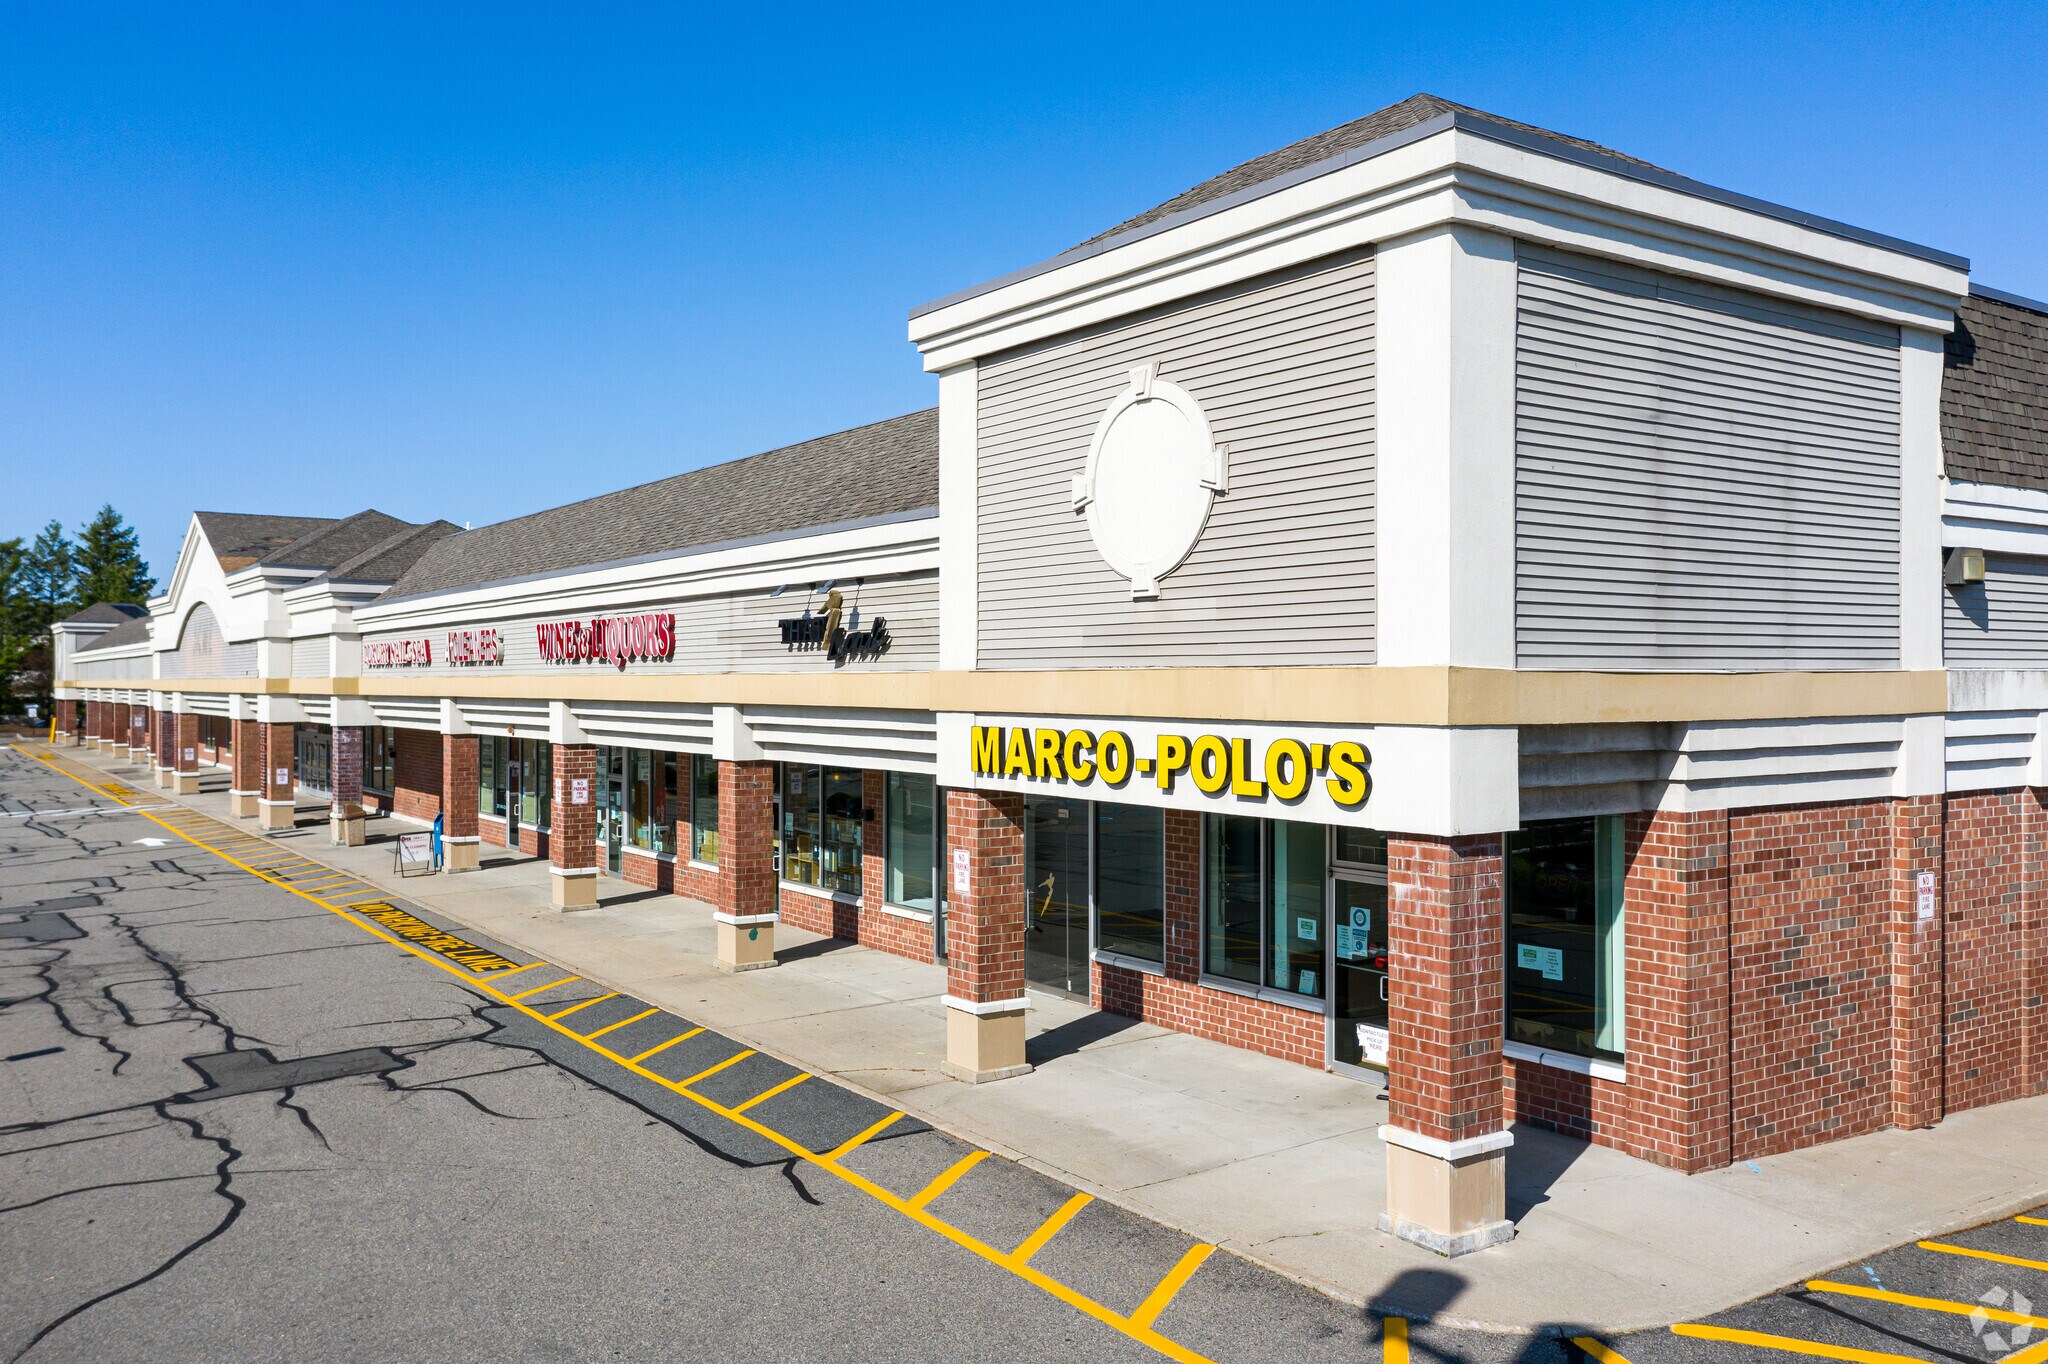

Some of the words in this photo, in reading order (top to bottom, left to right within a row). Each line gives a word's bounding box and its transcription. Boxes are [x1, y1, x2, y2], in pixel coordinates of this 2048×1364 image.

[537, 621, 577, 660] WINE
[579, 627, 590, 659] &
[591, 613, 672, 667] LIQUORS
[971, 726, 1369, 805] MARCO-POLO'S
[958, 854, 965, 862] NO
[955, 862, 969, 871] PARKING
[1922, 876, 1930, 885] NO
[1919, 885, 1933, 895] PARKING
[1922, 895, 1930, 903] FIRE
[1922, 903, 1931, 911] LANE
[365, 911, 442, 936] PARKING
[411, 935, 476, 951] FIRE
[443, 949, 519, 972] LANE
